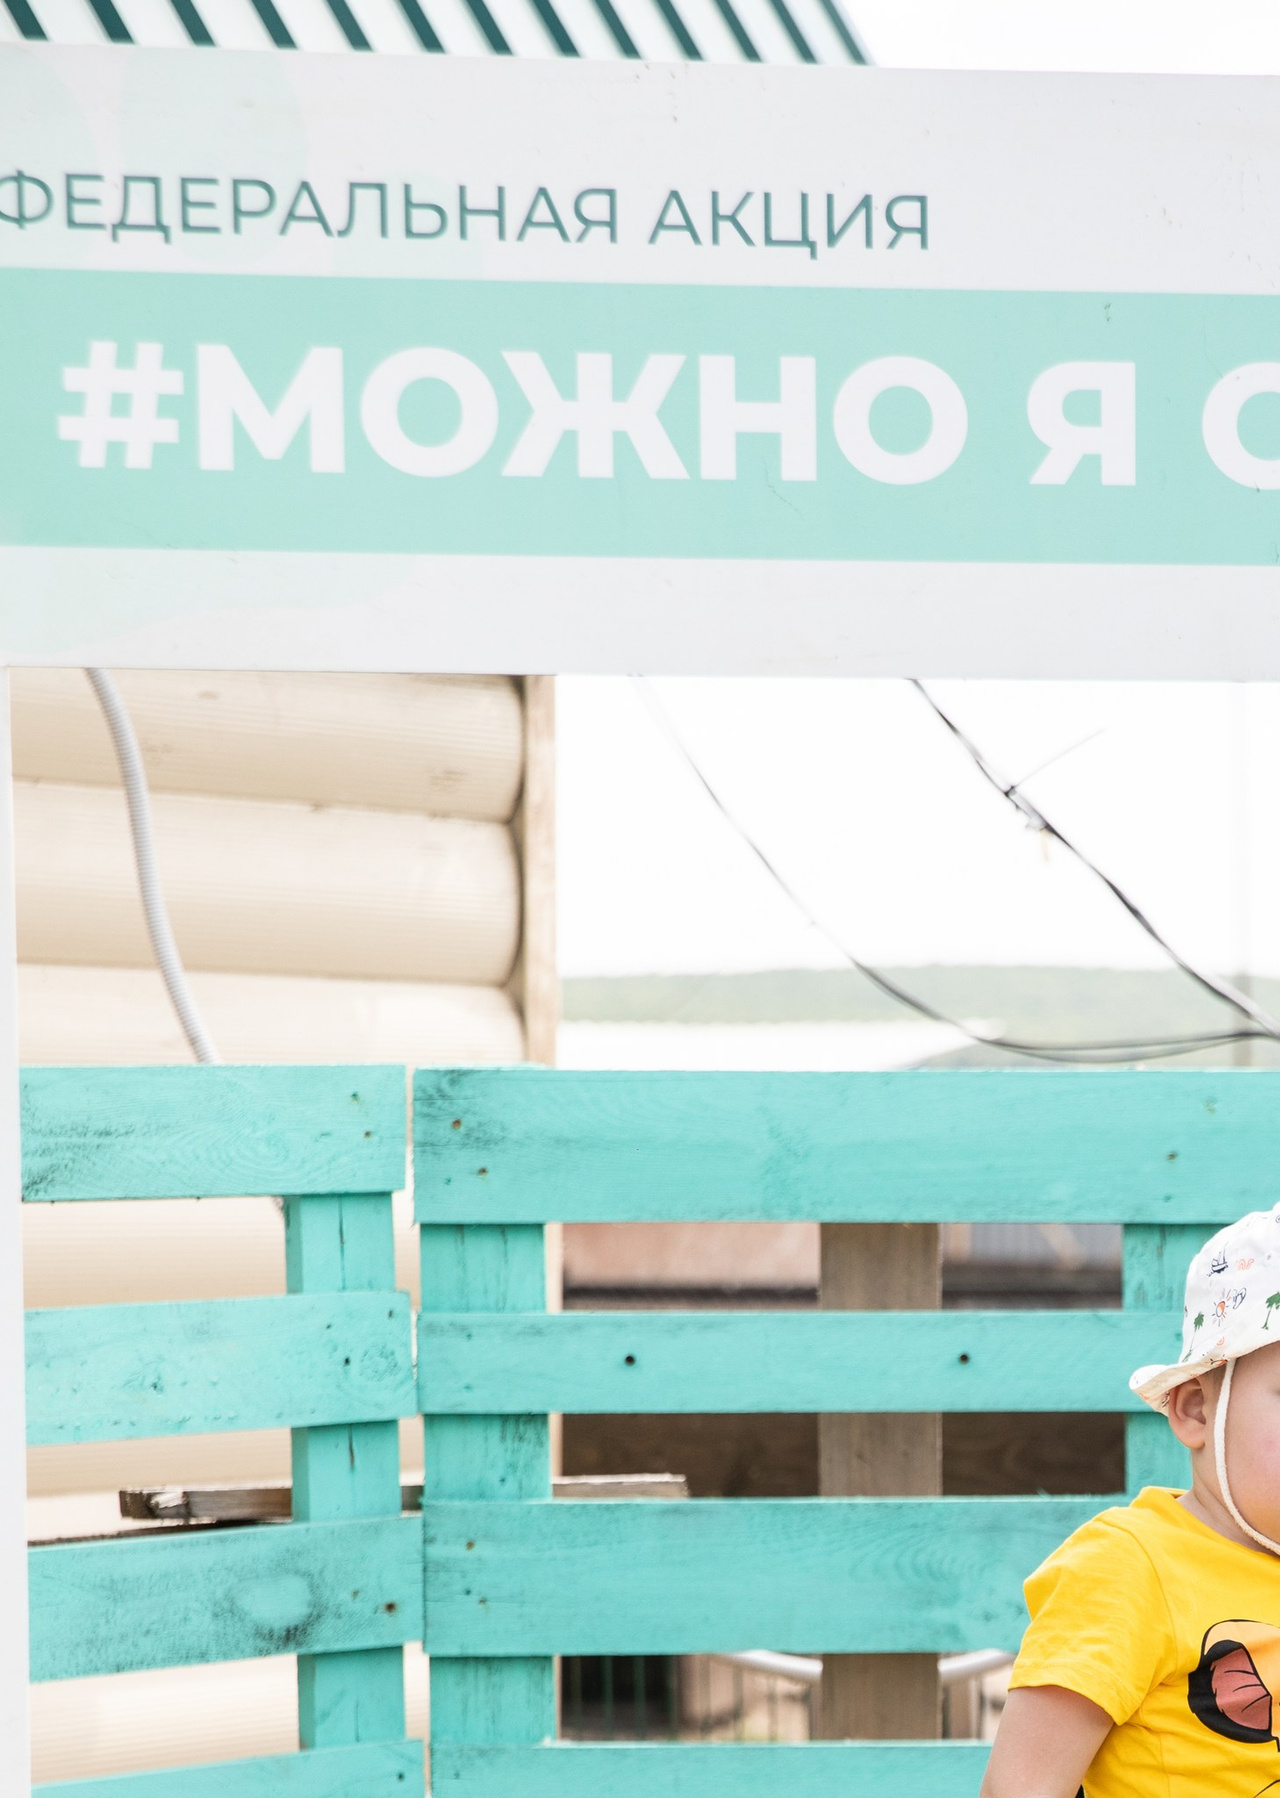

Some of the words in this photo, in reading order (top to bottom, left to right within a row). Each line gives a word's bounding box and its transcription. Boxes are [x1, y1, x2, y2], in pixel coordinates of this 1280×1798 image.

[0, 169, 618, 244] ФЕДЕРАЛЬНАЯ
[648, 189, 930, 260] АКЦИЯ
[57, 340, 968, 485] #МОЖНО
[1026, 360, 1137, 486] Я
